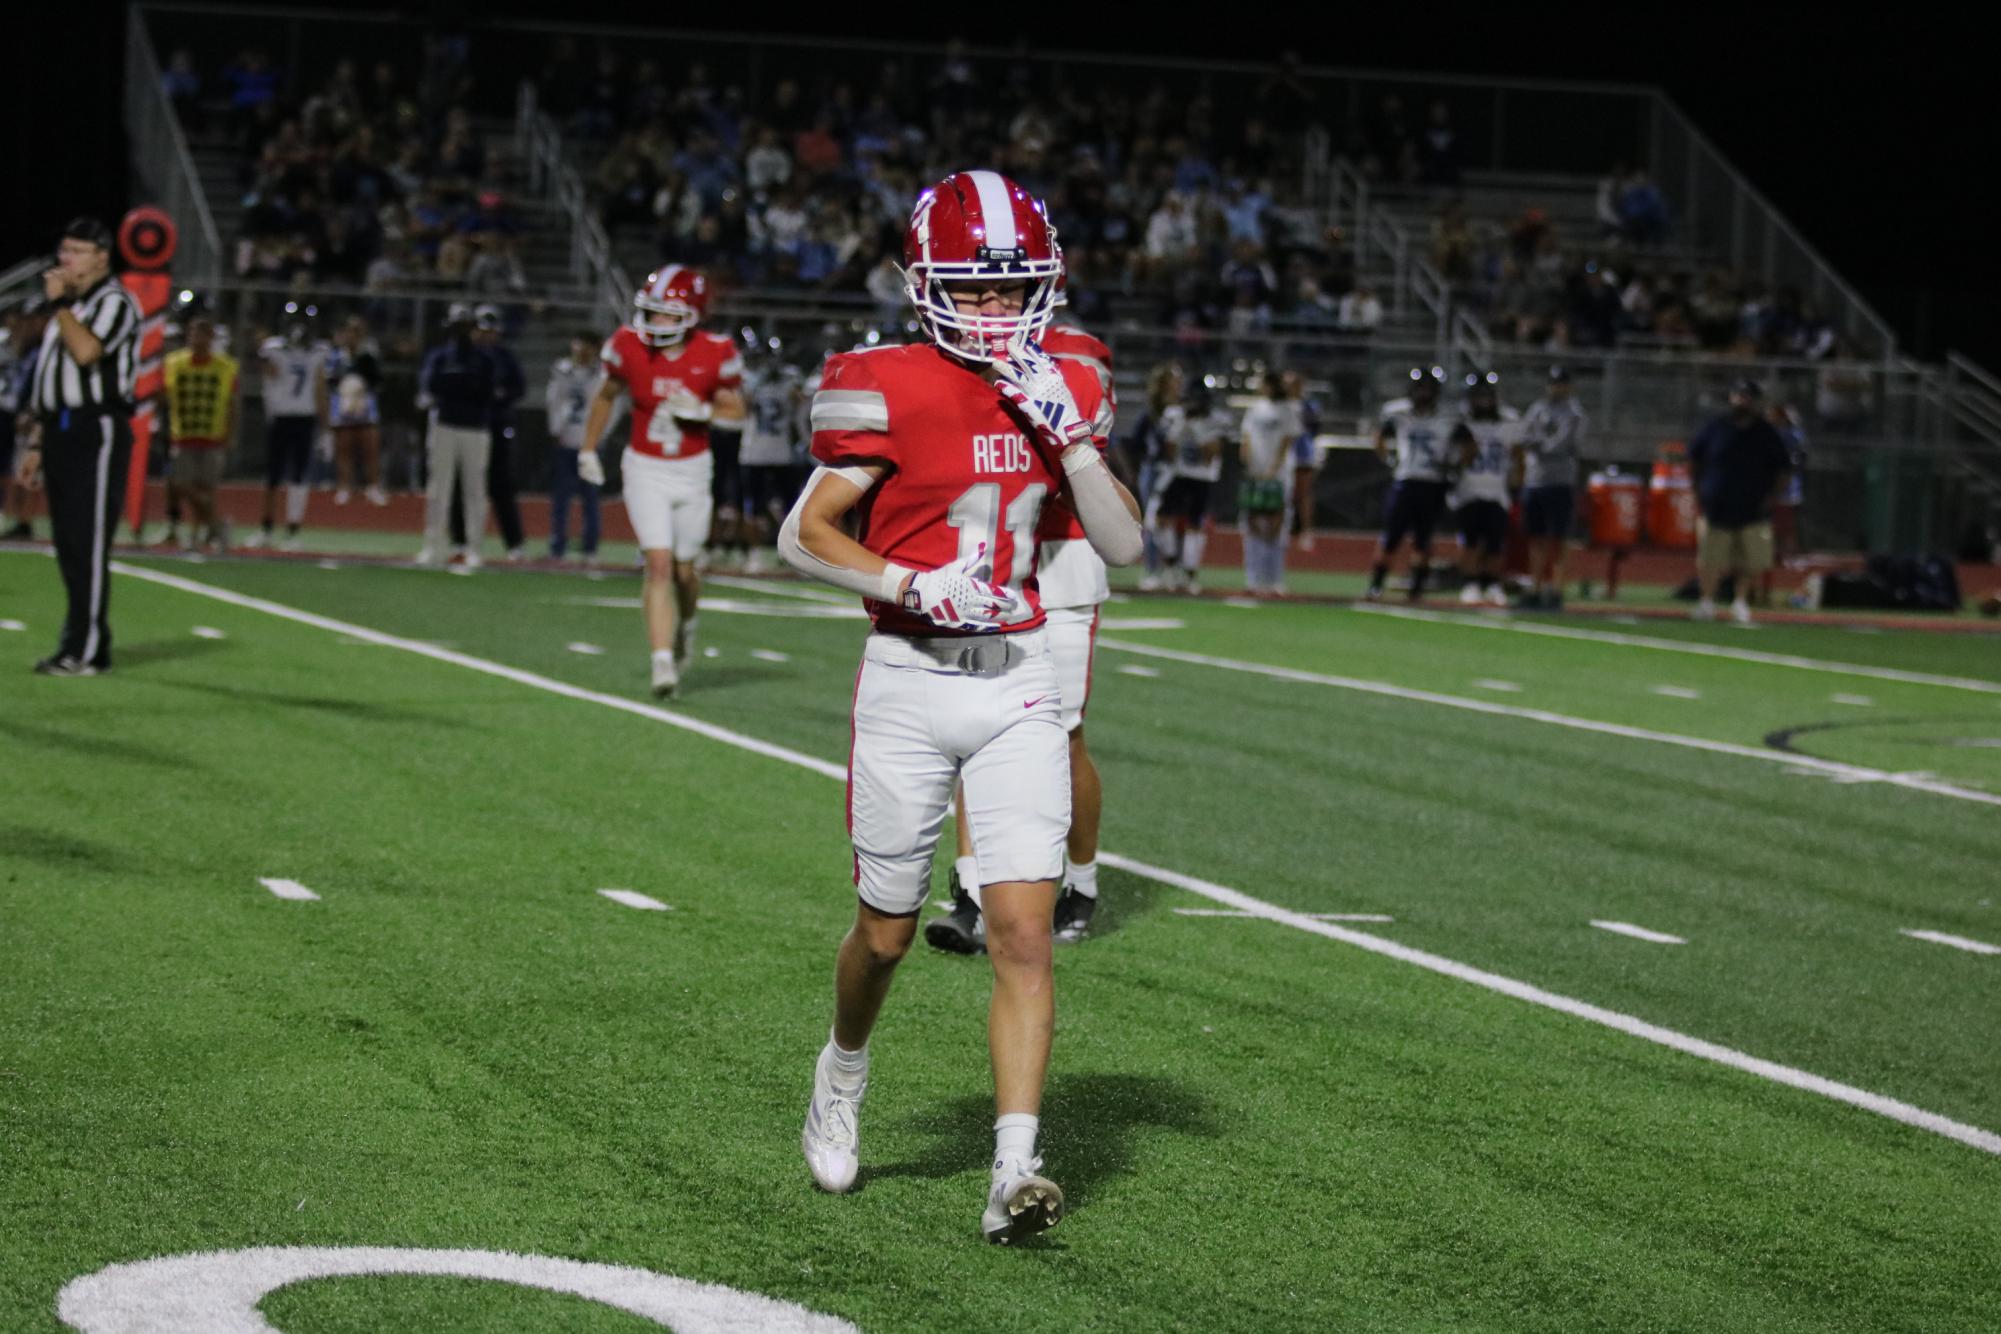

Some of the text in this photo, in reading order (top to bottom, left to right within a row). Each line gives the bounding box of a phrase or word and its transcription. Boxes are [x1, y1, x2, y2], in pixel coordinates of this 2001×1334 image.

[289, 363, 307, 398] 7
[646, 398, 684, 456] 4
[973, 434, 1031, 474] REDS
[947, 482, 1048, 626] 11
